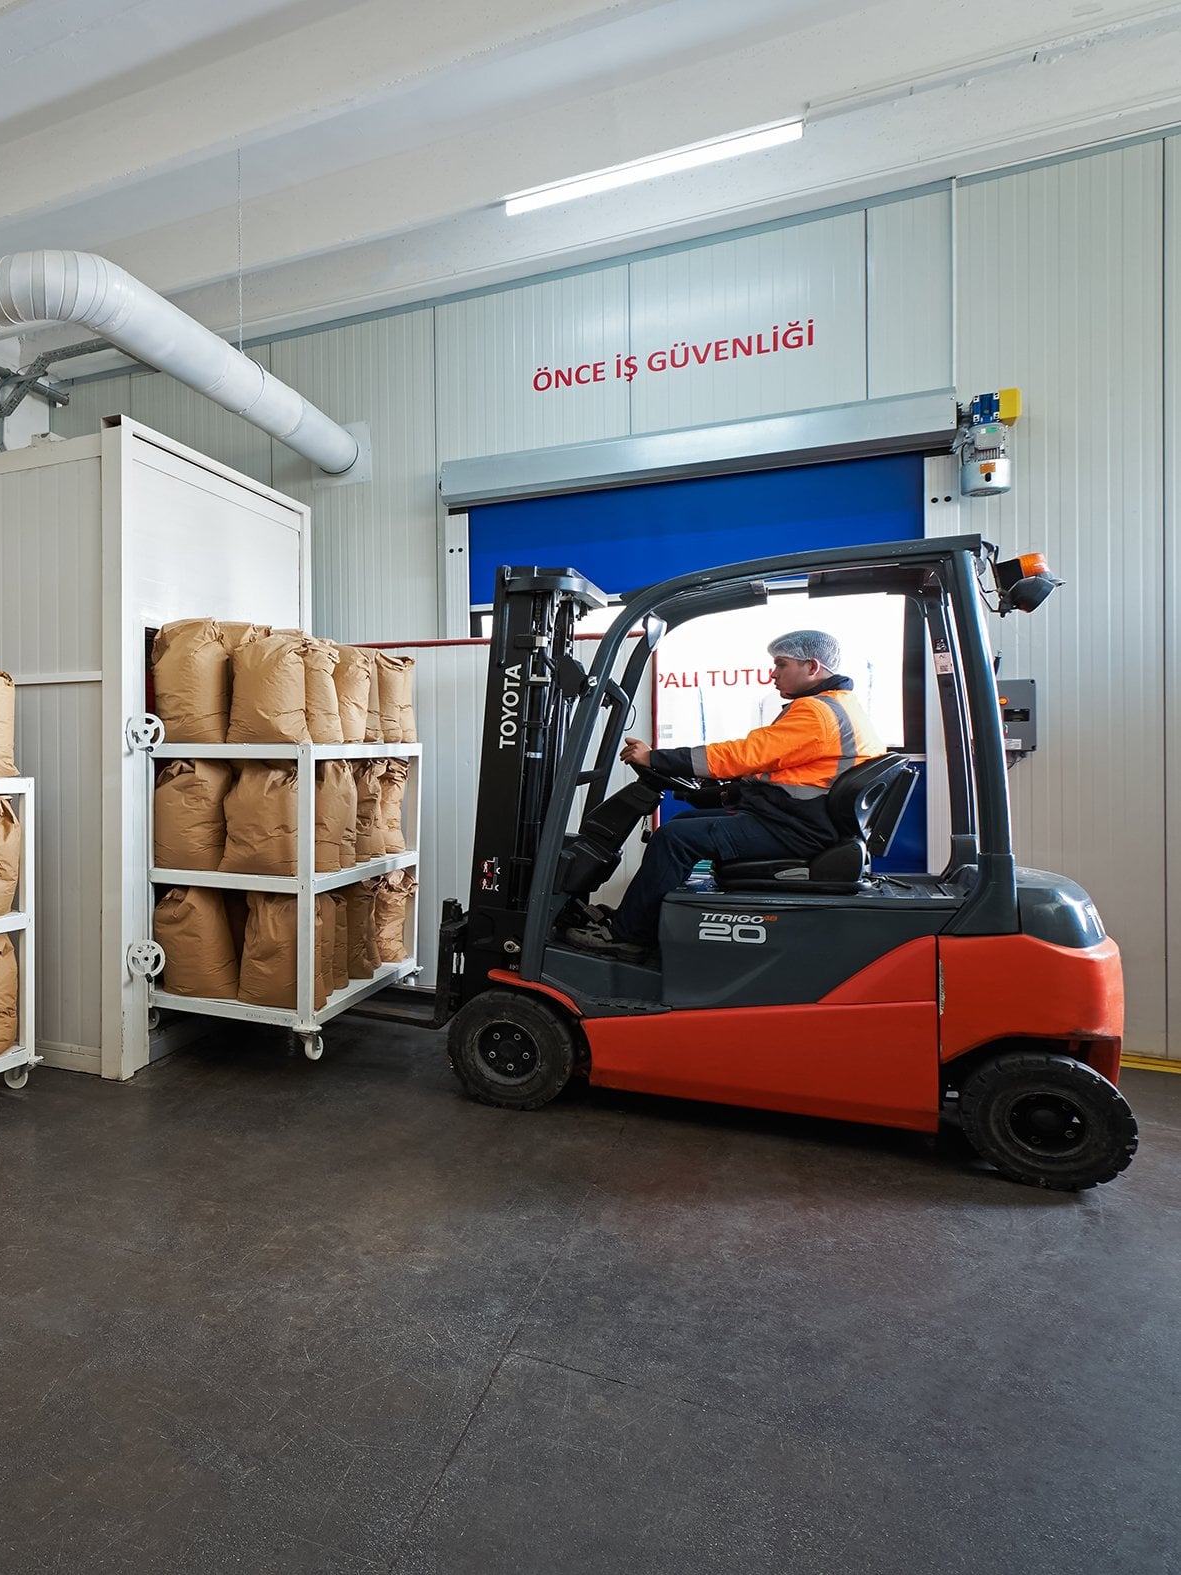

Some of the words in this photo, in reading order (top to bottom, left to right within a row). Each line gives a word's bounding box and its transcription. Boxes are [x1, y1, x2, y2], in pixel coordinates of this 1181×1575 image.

[532, 362, 606, 392] ÖNCE
[615, 354, 638, 382] İŞ
[647, 319, 815, 373] GÜVENLİĞİ
[499, 663, 522, 749] TOYOTA
[699, 922, 767, 944] 20
